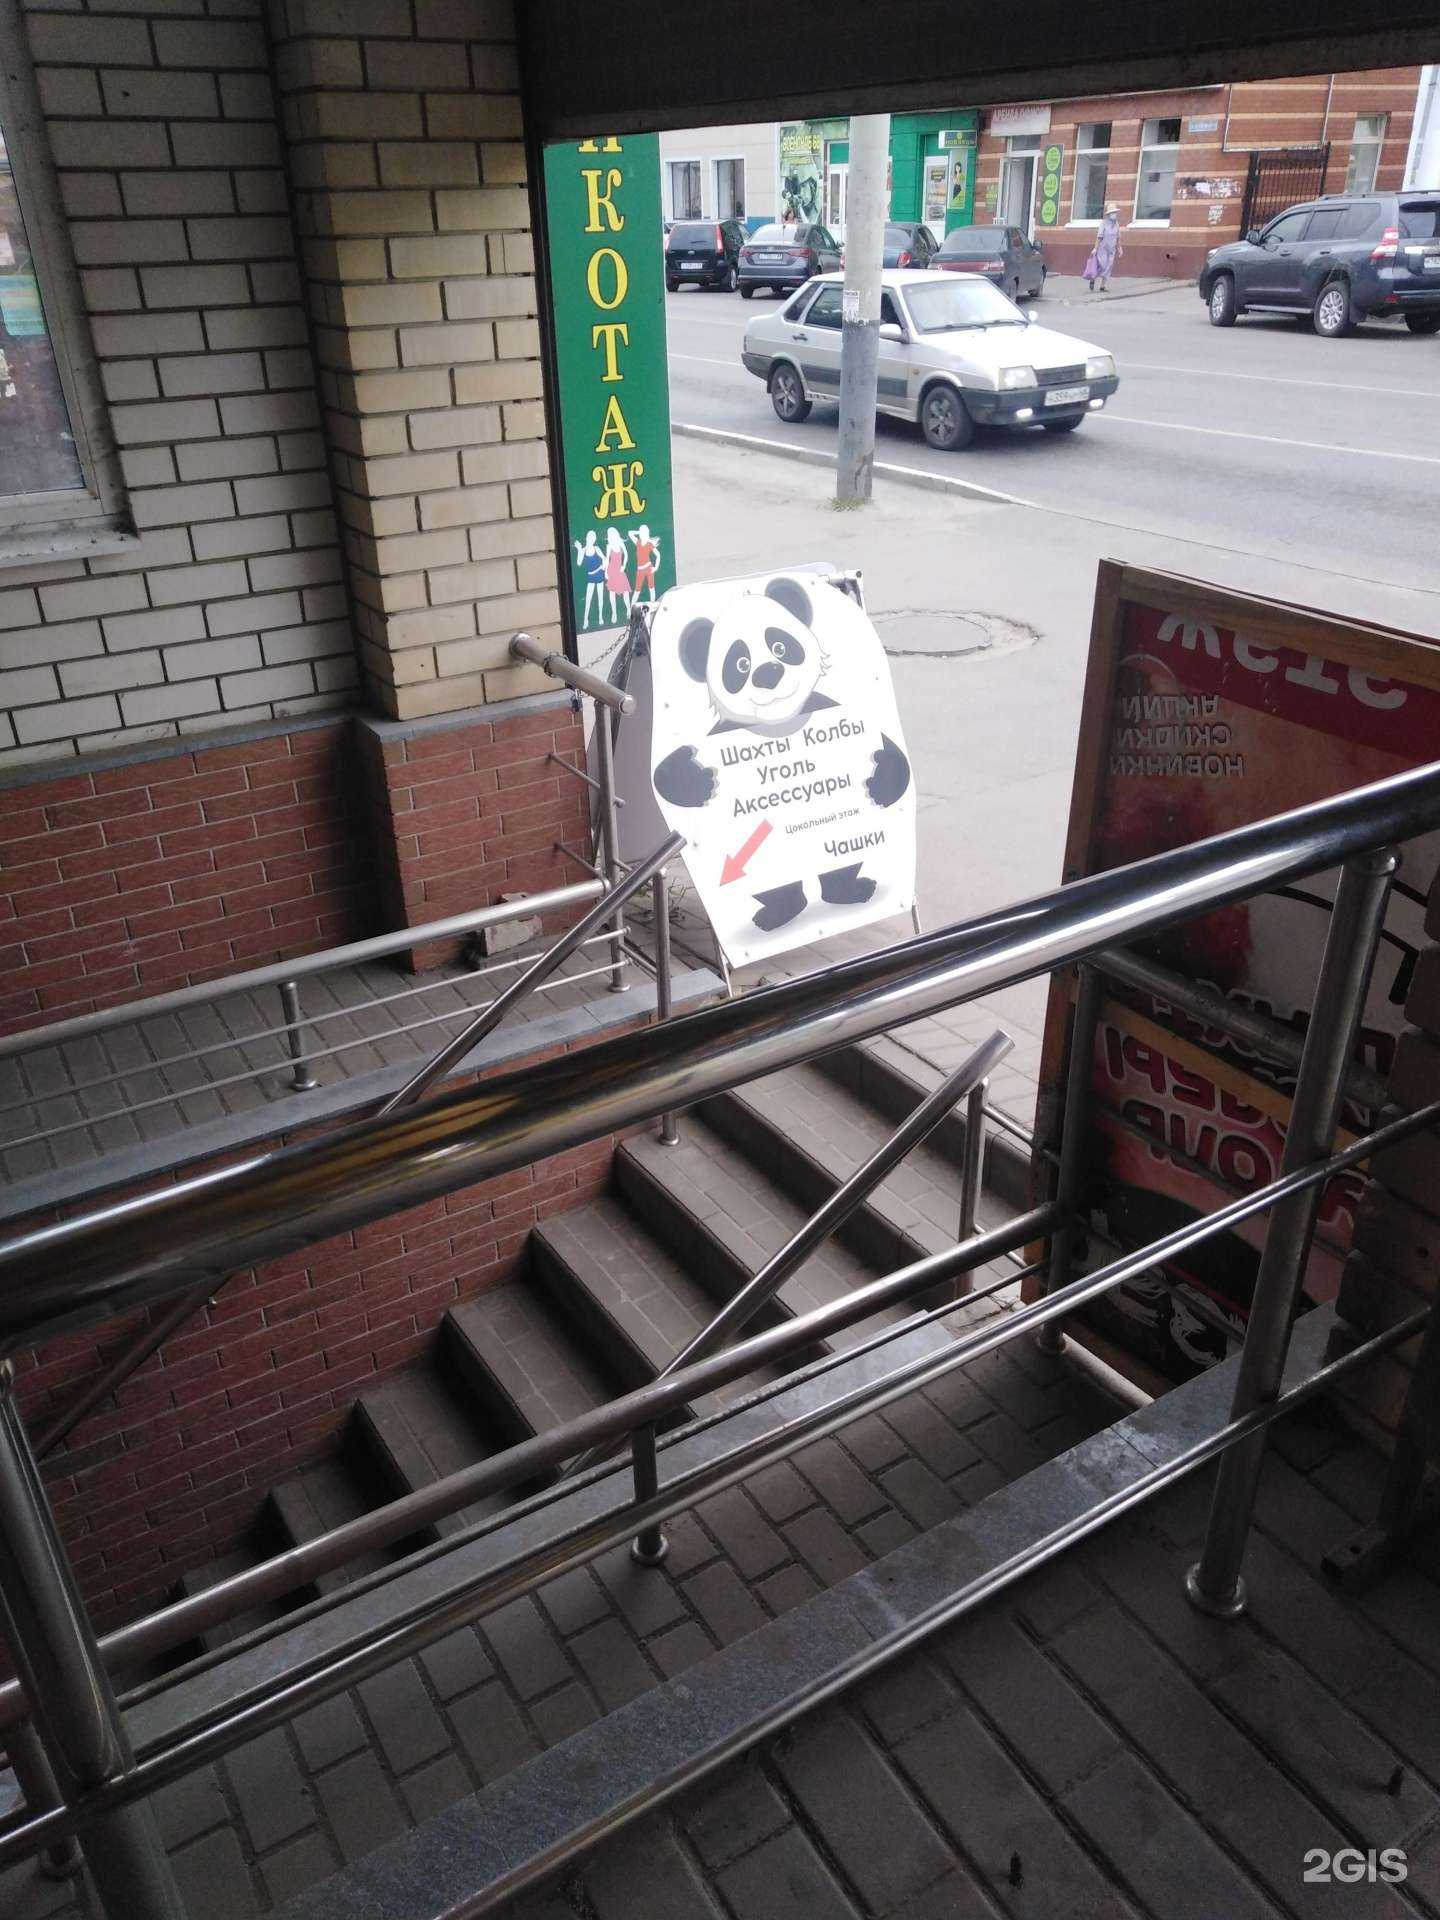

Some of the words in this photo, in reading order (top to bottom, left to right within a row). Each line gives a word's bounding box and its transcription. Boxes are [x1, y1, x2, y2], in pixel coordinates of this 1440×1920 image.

[578, 135, 647, 520] КОТАЖ
[1120, 693, 1219, 721] АКЦИИ
[720, 738, 791, 767] Шахты
[803, 719, 866, 749] Колбы
[1113, 724, 1232, 749] СКИДКИ
[757, 758, 816, 785] Уголь
[1108, 754, 1244, 777] НОВИНКИ
[733, 772, 852, 818] Аксессуары
[785, 812, 837, 835] Цокольный
[838, 807, 860, 823] этаж
[824, 829, 886, 858] Чашки
